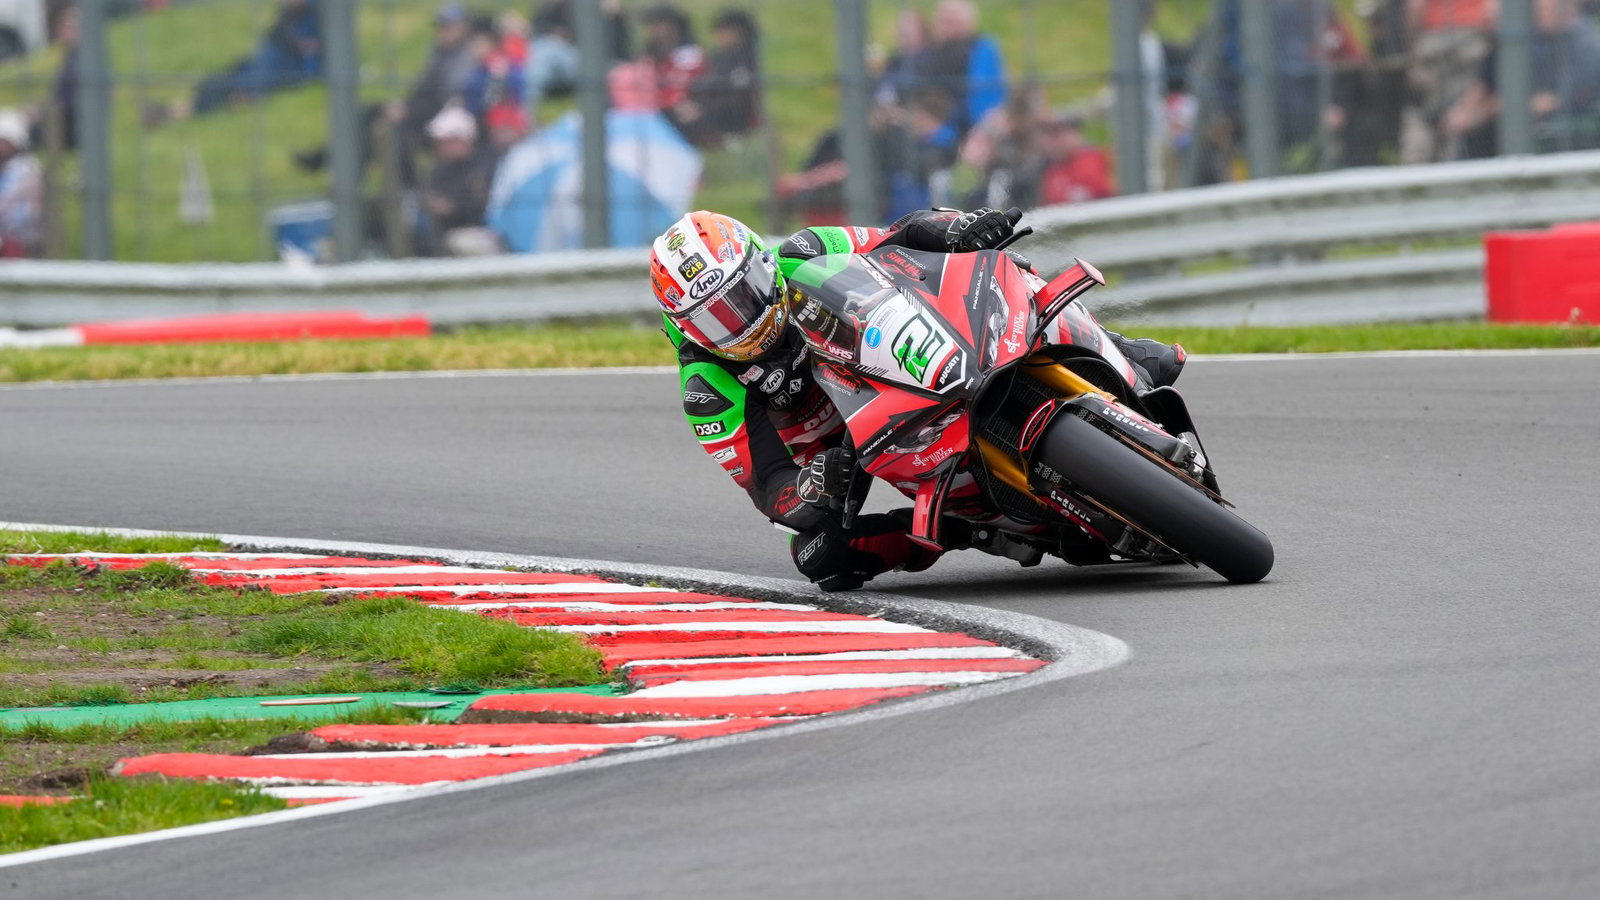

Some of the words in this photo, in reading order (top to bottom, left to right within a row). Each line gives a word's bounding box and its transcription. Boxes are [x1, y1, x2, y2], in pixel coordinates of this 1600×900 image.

[685, 261, 704, 279] CAB
[695, 269, 721, 296] Arai
[828, 346, 854, 360] WRS
[891, 312, 946, 384] 2
[939, 356, 960, 385] DUCATI
[1102, 407, 1149, 432] PIRELLI
[863, 429, 893, 455] PANIGALE
[1050, 490, 1091, 523] PIRELLI
[798, 532, 826, 565] RST
